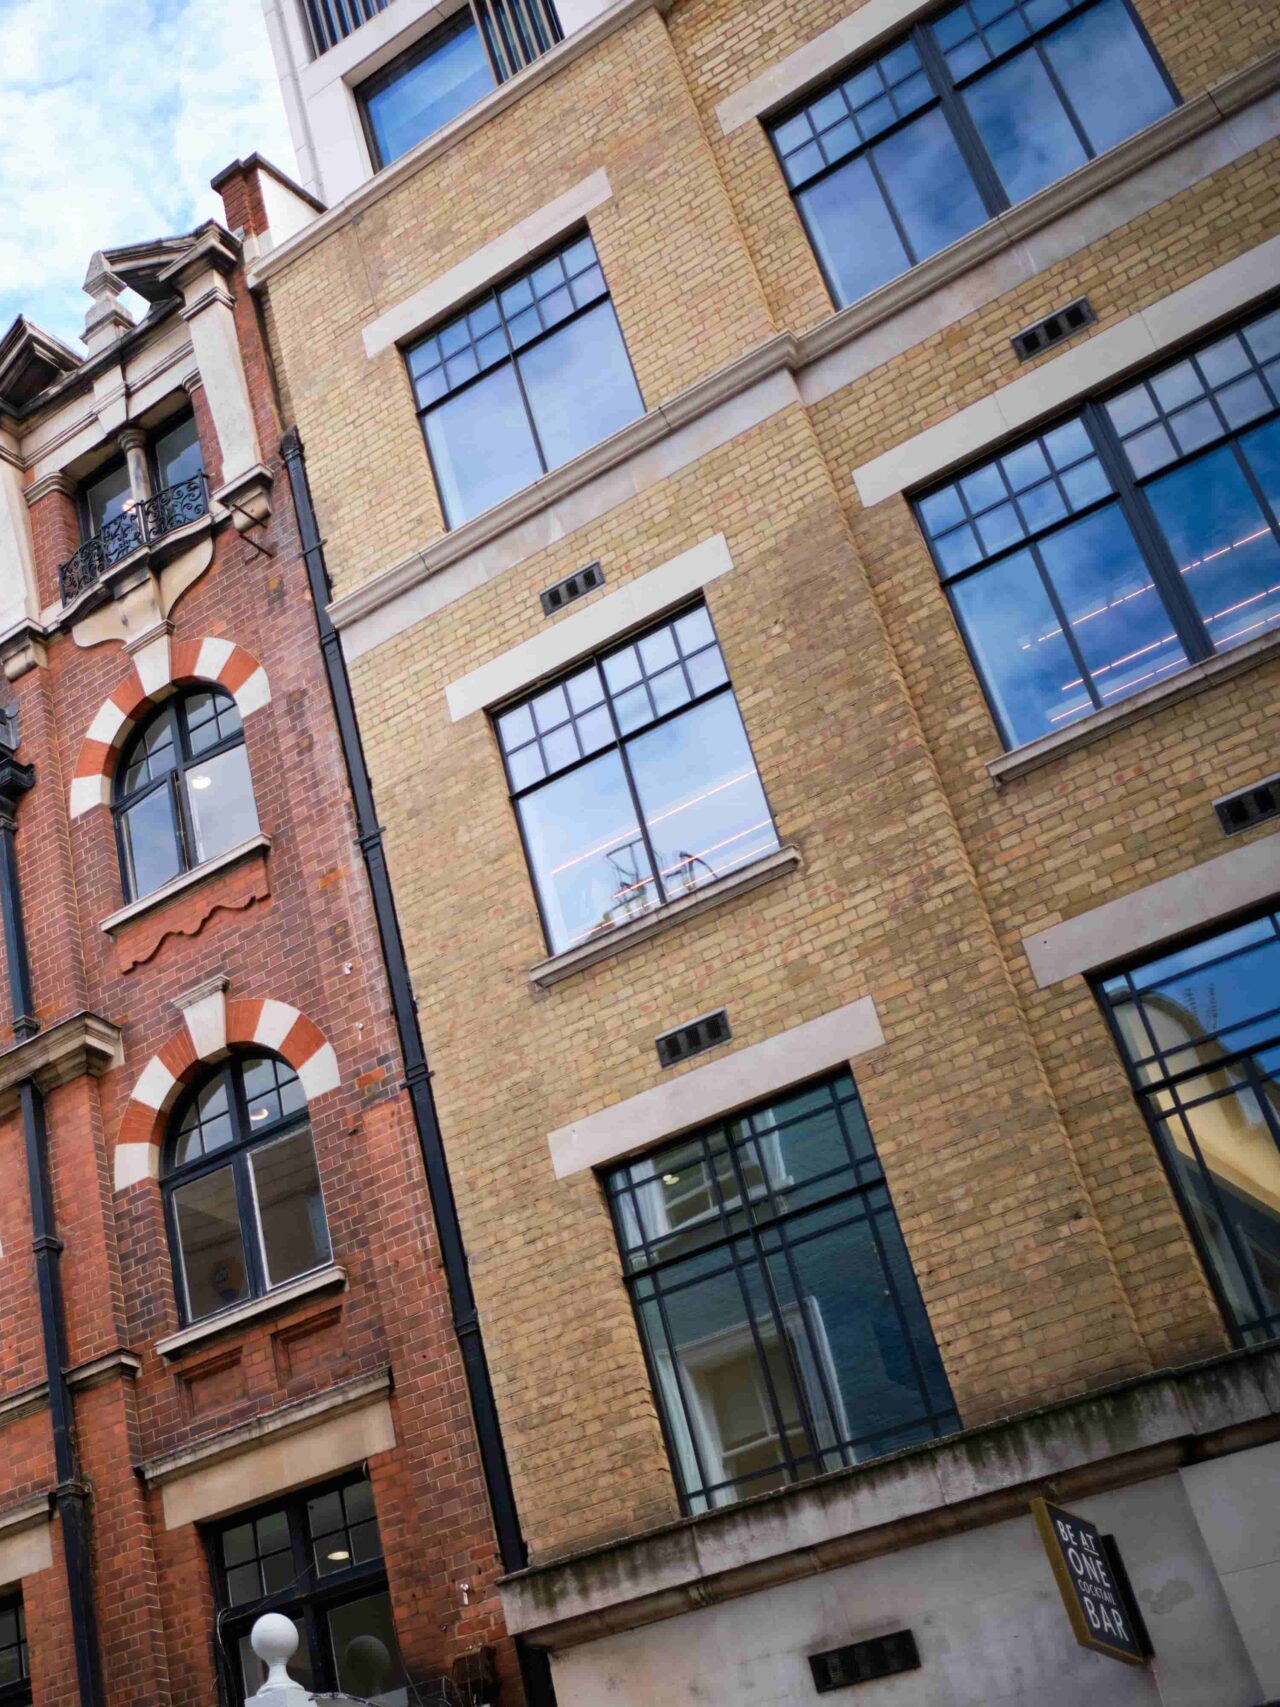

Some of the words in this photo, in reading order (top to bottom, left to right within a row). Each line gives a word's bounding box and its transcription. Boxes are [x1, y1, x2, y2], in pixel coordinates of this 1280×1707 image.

[1056, 1519, 1078, 1546] BE
[1079, 1530, 1097, 1553] AT
[1068, 1547, 1111, 1589] ONE
[1077, 1578, 1117, 1606] COCKTAIL
[1083, 1596, 1130, 1642] BAR
